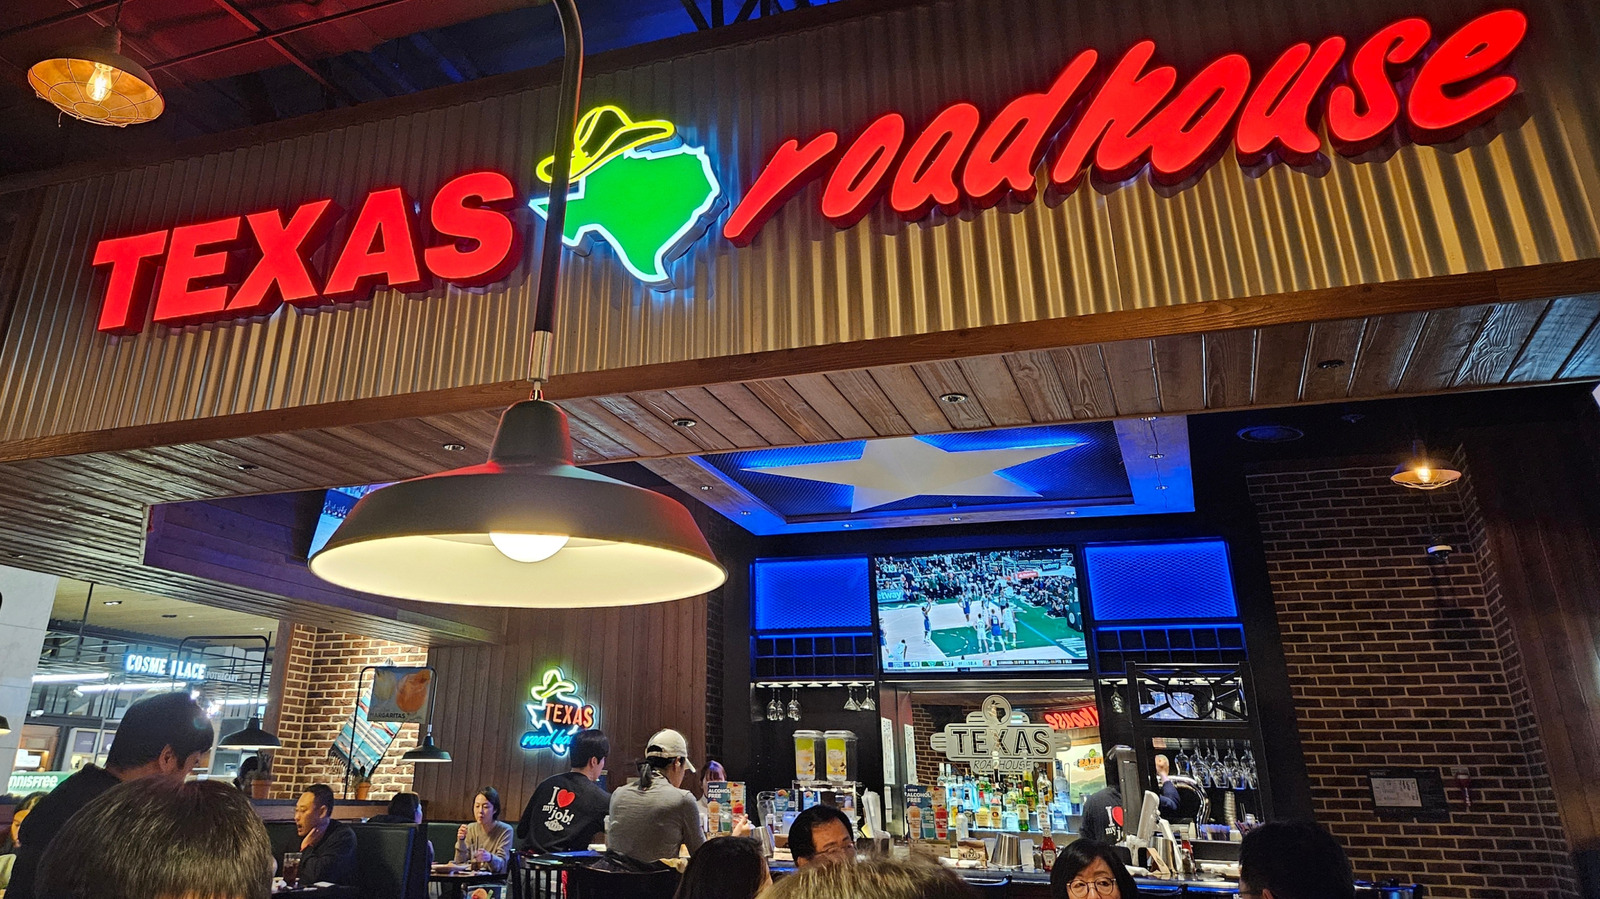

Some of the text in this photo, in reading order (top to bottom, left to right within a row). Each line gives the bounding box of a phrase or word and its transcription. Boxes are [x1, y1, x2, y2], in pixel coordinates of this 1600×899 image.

[93, 8, 1528, 331] TEXAS roadhouse
[125, 653, 168, 676] COSME
[545, 703, 594, 728] TEXAS
[521, 728, 572, 747] roadho
[951, 729, 1052, 756] TEXAS
[973, 760, 1032, 770] ROAHOUSE
[548, 786, 560, 805] I
[541, 804, 555, 814] my
[548, 806, 575, 825] job!
[1105, 805, 1115, 827] I
